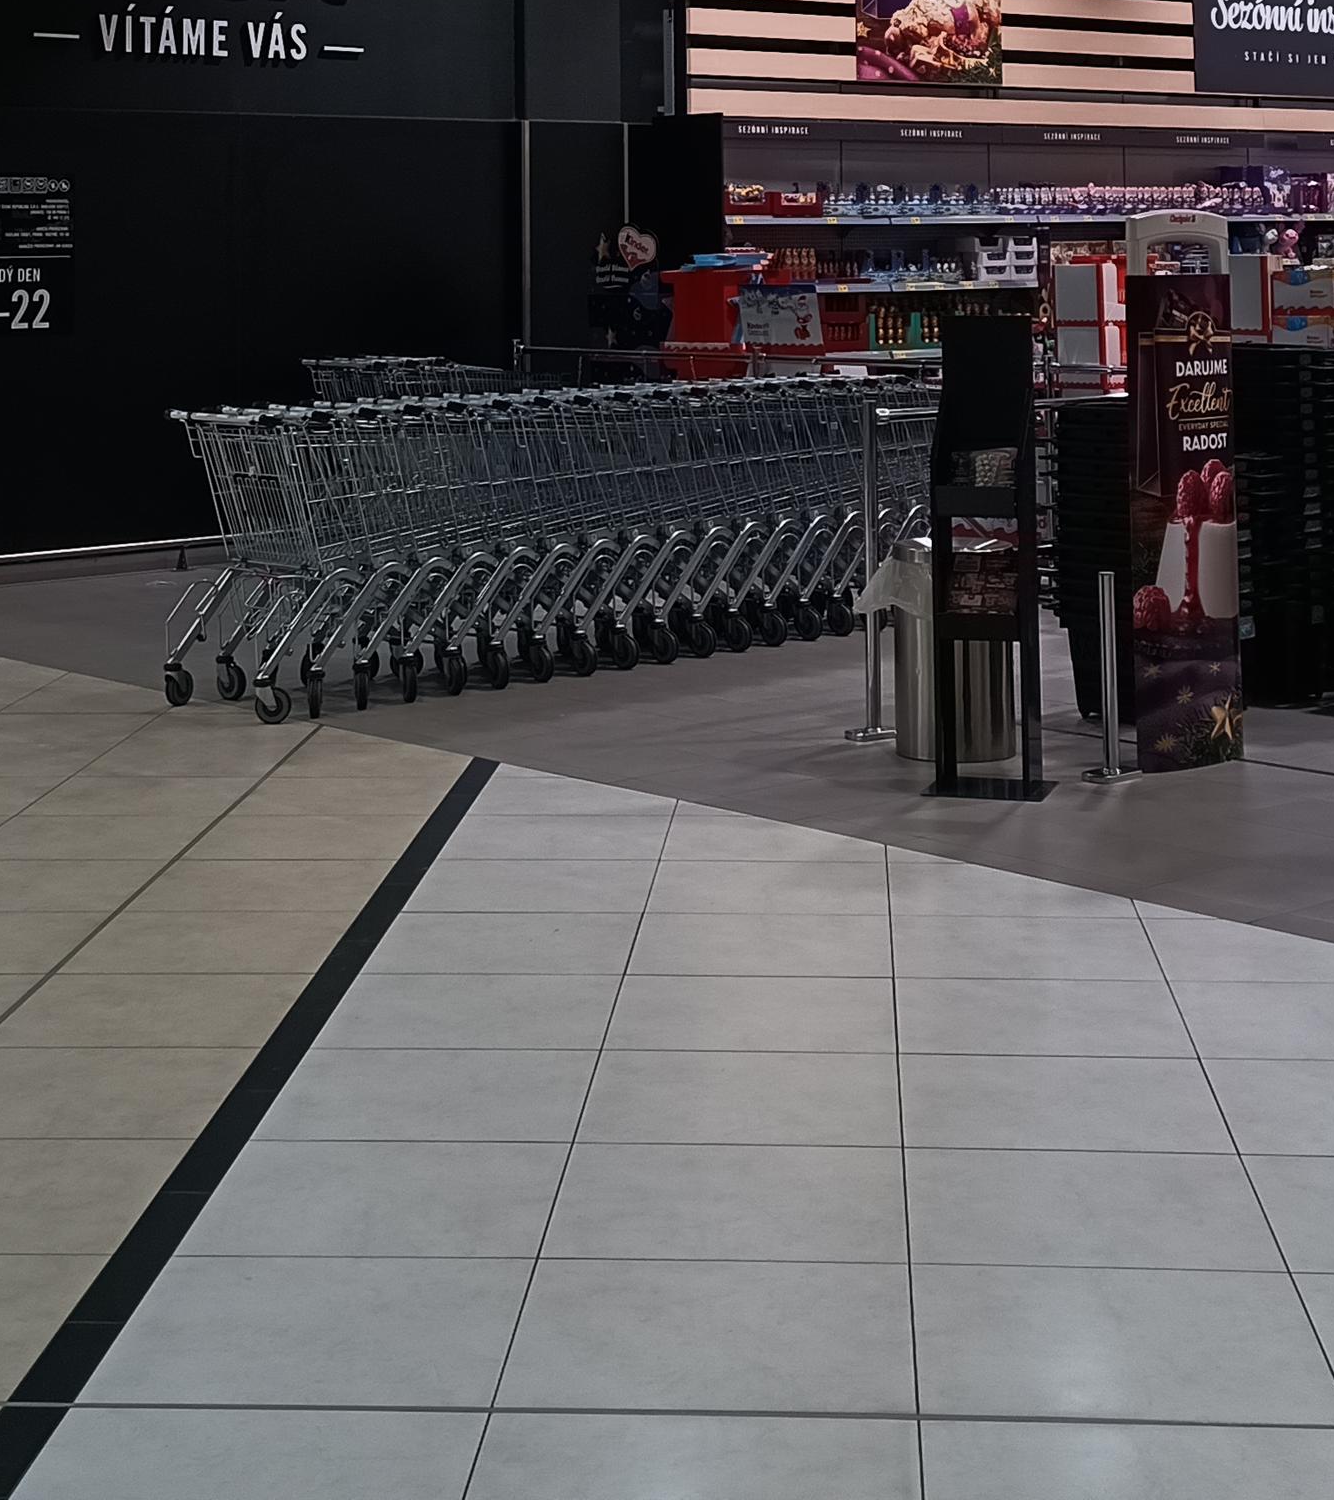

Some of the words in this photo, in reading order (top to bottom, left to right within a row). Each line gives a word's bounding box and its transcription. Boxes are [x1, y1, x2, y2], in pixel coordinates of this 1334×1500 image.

[98, 3, 229, 58] VÍTÁME
[247, 12, 308, 61] VÁS
[1288, 53, 1299, 63] SI
[17, 268, 41, 282] DEN
[1175, 358, 1228, 378] DARUJME
[1166, 381, 1234, 420] Excellent
[1182, 432, 1228, 452] RADOST
